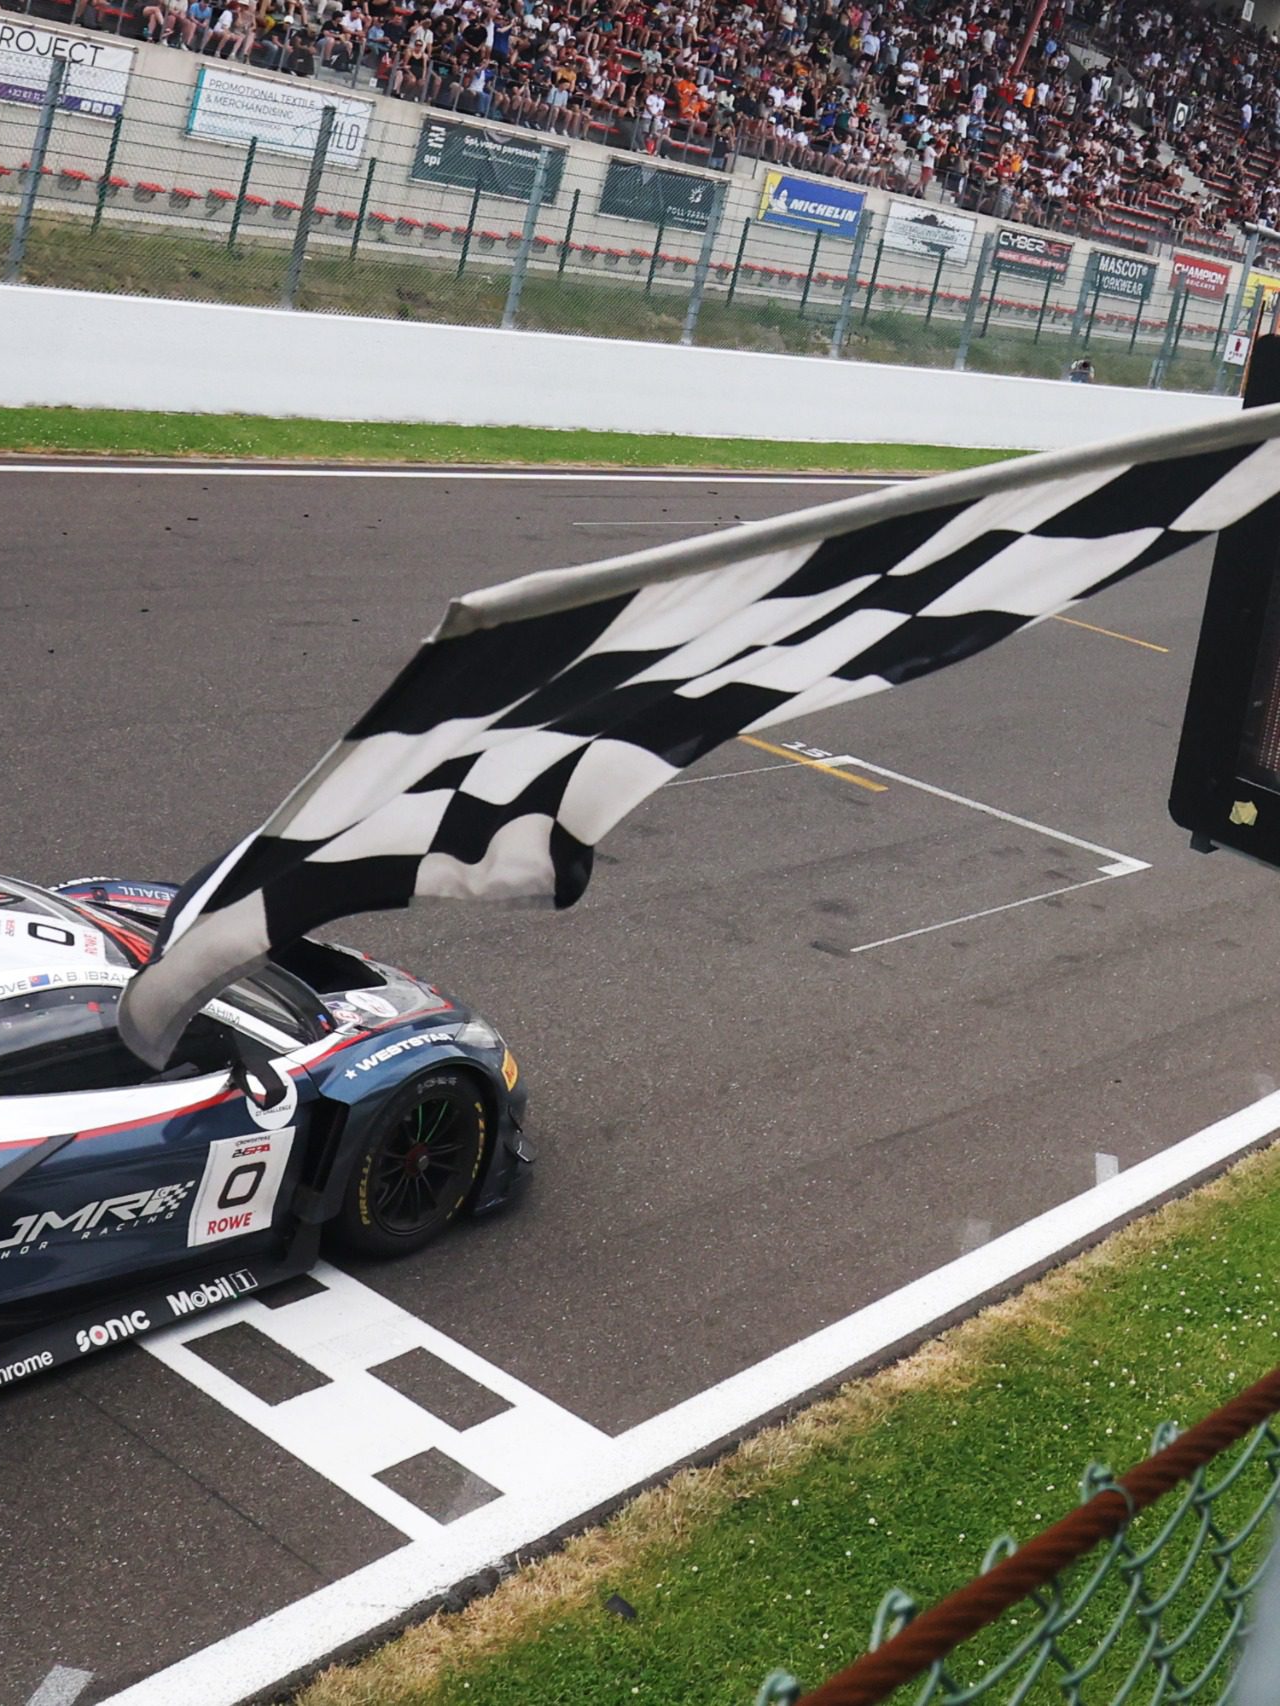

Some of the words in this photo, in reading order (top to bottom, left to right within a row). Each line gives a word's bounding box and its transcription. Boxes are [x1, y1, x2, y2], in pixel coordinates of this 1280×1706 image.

[209, 79, 277, 103] PROMOTIONAL
[281, 94, 316, 108] TEXTILE
[214, 96, 294, 119] MERCHANDISING
[423, 152, 441, 167] spi
[789, 199, 857, 223] MICHELIN
[1174, 263, 1226, 285] CHAMPION
[355, 1032, 454, 1073] WESTSTAR
[81, 1210, 176, 1240] RACING
[207, 1212, 253, 1236] ROWE
[166, 1275, 235, 1317] Mobil
